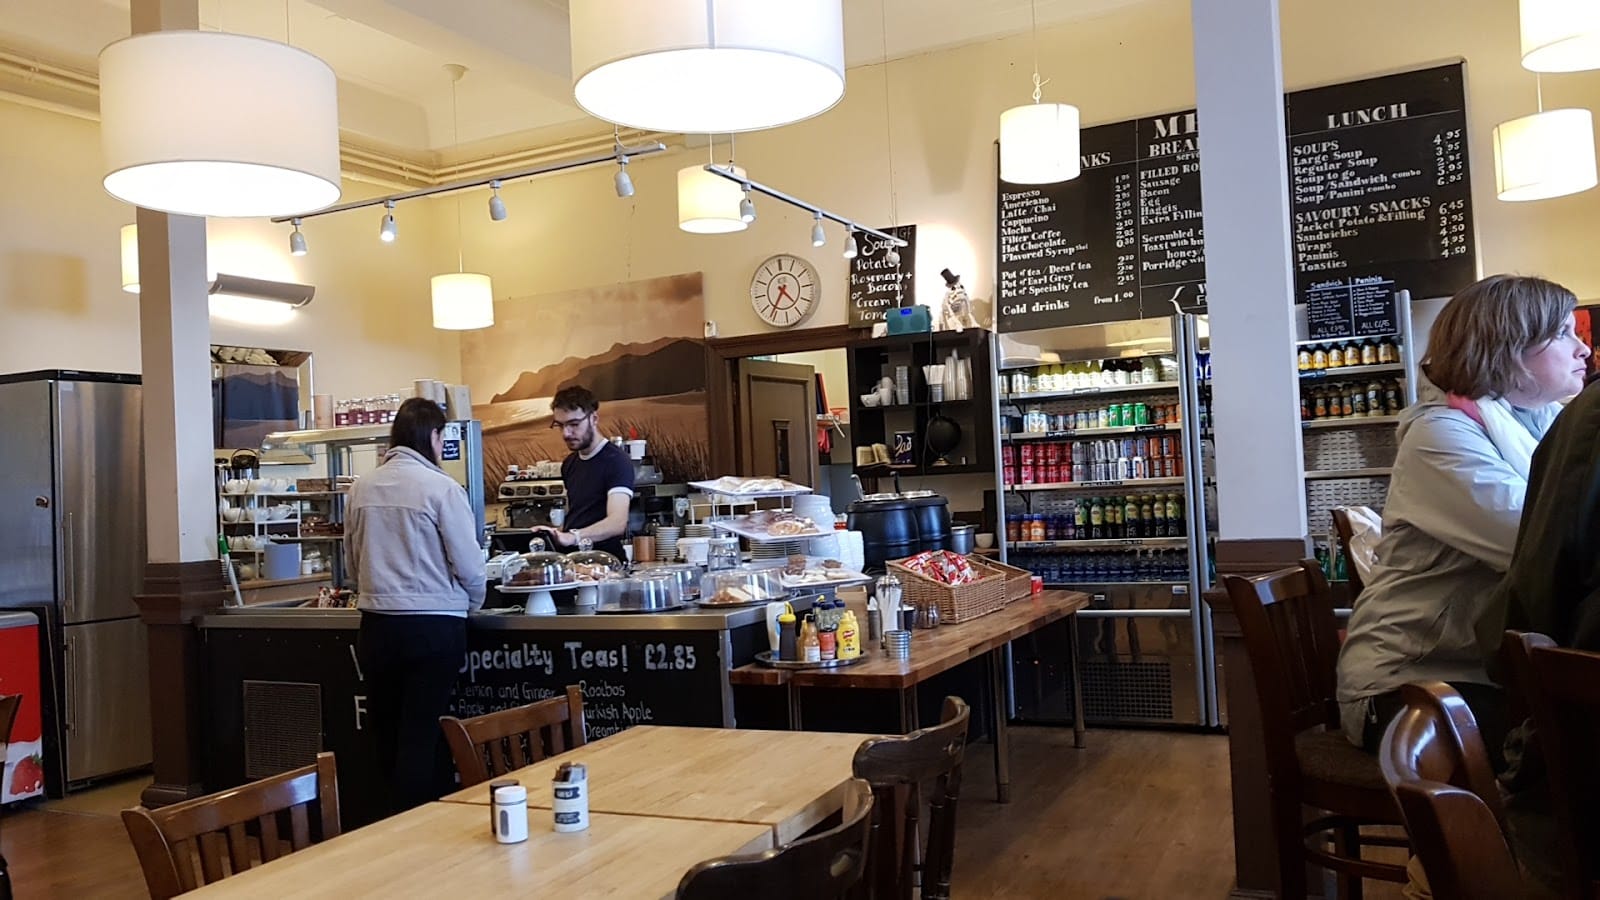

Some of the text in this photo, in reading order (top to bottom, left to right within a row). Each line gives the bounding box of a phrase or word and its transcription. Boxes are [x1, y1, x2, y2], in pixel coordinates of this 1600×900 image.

[1327, 103, 1408, 129] LUNCH
[1432, 128, 1462, 146] 4.95
[1293, 140, 1340, 156] SOUPS
[1436, 141, 1460, 156] 3.95
[1293, 148, 1363, 167] Large Soup
[1140, 166, 1179, 180] FILLED
[1294, 156, 1378, 176] Regular Soup
[1437, 162, 1463, 176] 5.95
[1140, 177, 1181, 189] Sausage
[1295, 170, 1356, 186] Soup to go
[1295, 169, 1422, 196] Soup/Sandwich combo
[1437, 173, 1464, 187] 6.95
[1002, 190, 1041, 202] Espresso
[1140, 188, 1170, 198] Bacon
[1296, 183, 1397, 205] Soup/Panini combo
[1002, 198, 1050, 210] Americano
[1140, 198, 1160, 207] Egg
[1439, 200, 1464, 215] 6.45
[1002, 208, 1027, 219] Latte
[1141, 204, 1178, 216] Haggis
[1296, 196, 1432, 224] SAVOURY SNACKS
[1002, 214, 1050, 228] Cappucino
[1141, 214, 1170, 226] Extra
[1296, 219, 1334, 234] Jacket
[1339, 214, 1376, 227] Potato
[1440, 214, 1464, 227] 3.95
[1001, 226, 1032, 236] Mocha
[1002, 230, 1062, 245] Filter Coffee
[1142, 228, 1194, 243] Scrambled
[1296, 227, 1358, 242] Sandwiches
[1439, 224, 1465, 237] 4.50
[1002, 238, 1067, 254] Hot Chocolate
[1143, 242, 1168, 252] Toast
[1170, 239, 1189, 248] with
[1297, 241, 1332, 254] Wraps
[1440, 234, 1465, 248] 4.95
[1002, 249, 1043, 262] Flavored
[1045, 246, 1074, 258] Syrup
[1298, 250, 1340, 262] Paninis
[1440, 245, 1466, 259] 4.50
[1002, 270, 1016, 280] Pot
[1027, 268, 1041, 277] tea
[1049, 262, 1076, 274] Decaf
[1078, 262, 1092, 270] tea
[1142, 260, 1188, 270] Porridge
[1298, 259, 1348, 272] Toasties
[852, 272, 904, 285] Rosemary
[1002, 280, 1016, 289] Pot
[1028, 275, 1048, 286] Earl
[1050, 274, 1074, 284] Grey
[867, 283, 902, 294] Bacon
[1002, 288, 1017, 298] Pot
[1028, 282, 1070, 296] Specialty
[1073, 280, 1088, 289] tea
[856, 298, 891, 308] Cream
[1002, 304, 1026, 316] Cold
[1032, 300, 1070, 312] drinks
[1094, 295, 1112, 304] from
[564, 642, 628, 672] Teas!
[645, 643, 696, 670] £2.85
[498, 683, 520, 700] and
[579, 680, 626, 698] Rooibos
[622, 700, 654, 724] Apple
